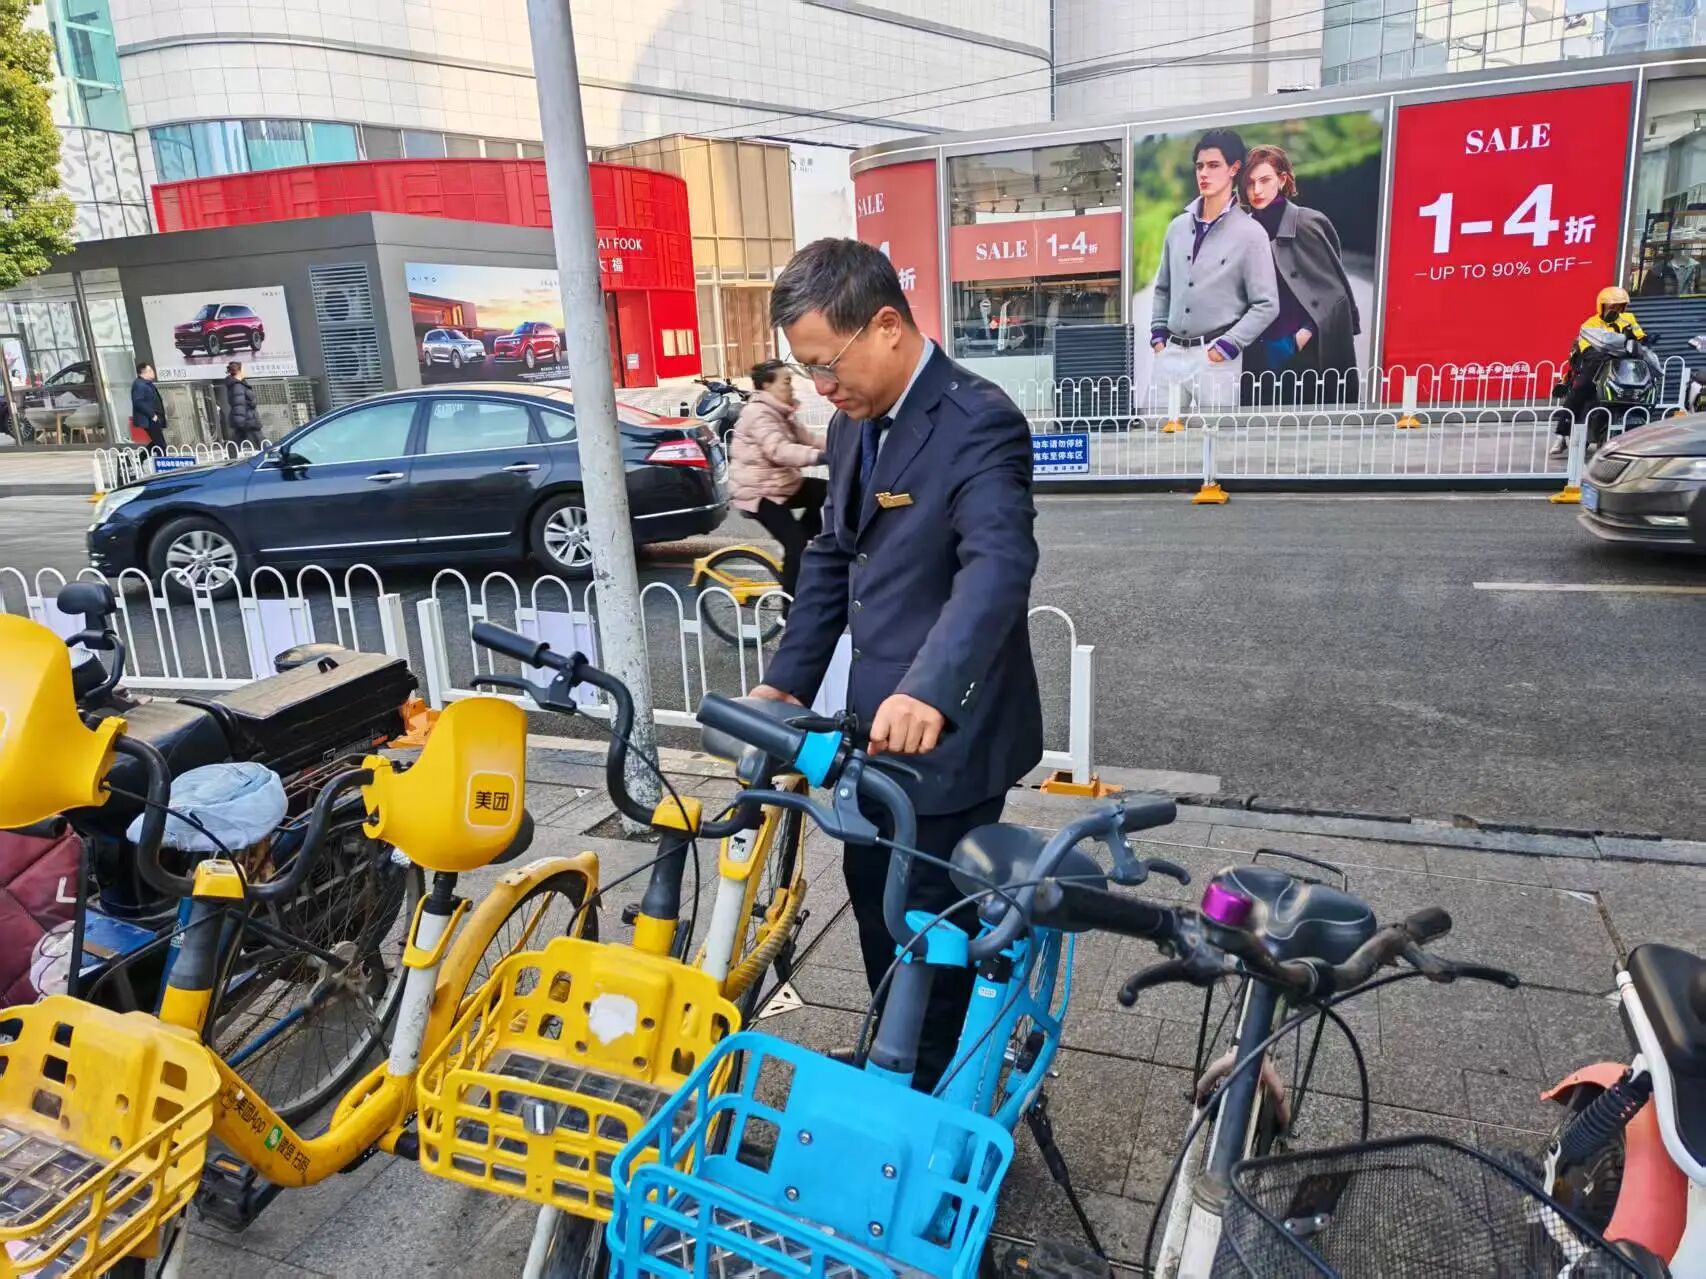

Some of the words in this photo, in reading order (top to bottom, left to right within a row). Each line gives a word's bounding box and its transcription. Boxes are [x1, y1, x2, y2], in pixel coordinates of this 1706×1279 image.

[1465, 123, 1551, 154] SALE
[857, 193, 885, 217] SALE
[613, 238, 643, 250] FOOK
[976, 240, 1028, 261] SALE
[1430, 267, 1455, 280] UP
[1461, 264, 1486, 279] TO
[1492, 261, 1531, 277] 90%
[1538, 257, 1577, 274] OFF
[474, 790, 509, 811] 美团
